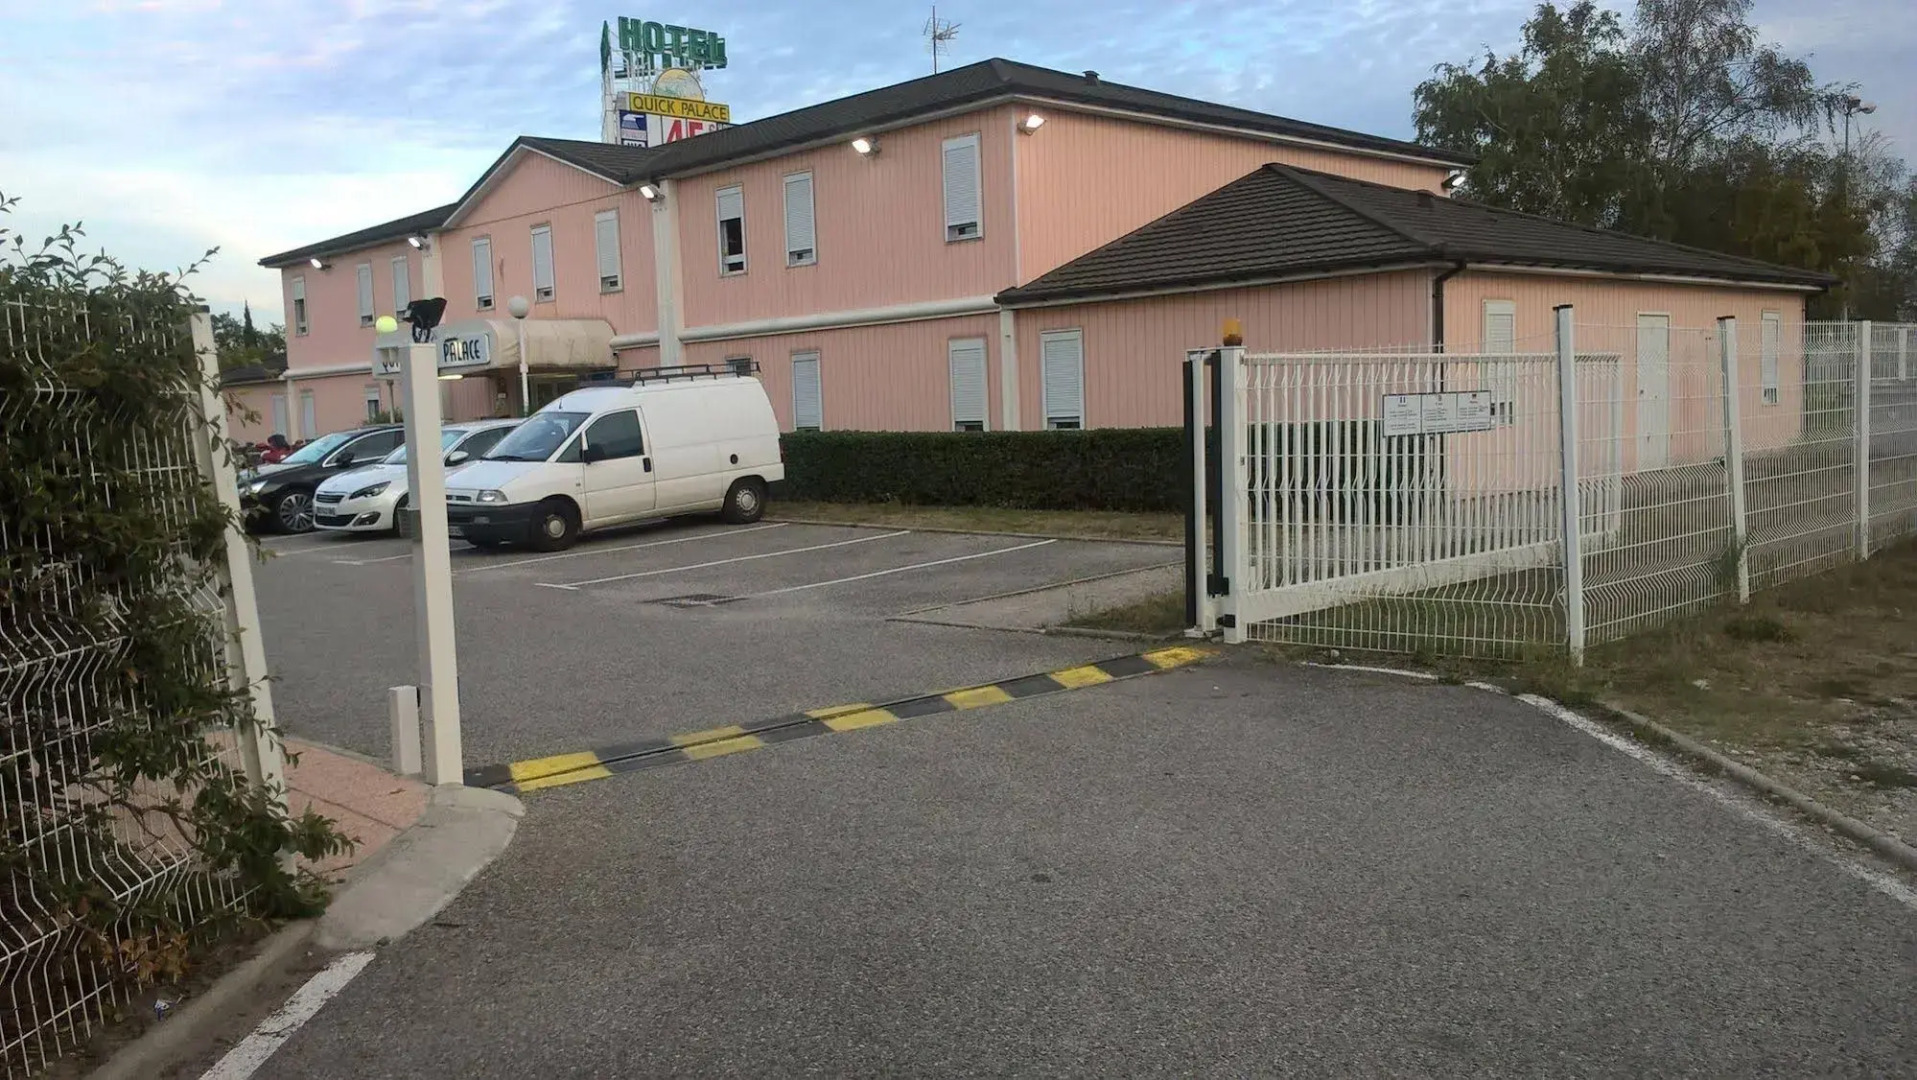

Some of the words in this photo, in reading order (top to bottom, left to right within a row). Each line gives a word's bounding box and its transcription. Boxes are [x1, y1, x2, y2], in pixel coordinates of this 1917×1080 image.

[618, 16, 727, 65] HOTEL
[633, 96, 676, 114] QUICK
[681, 102, 727, 120] PALACE
[443, 339, 481, 363] PALACE
